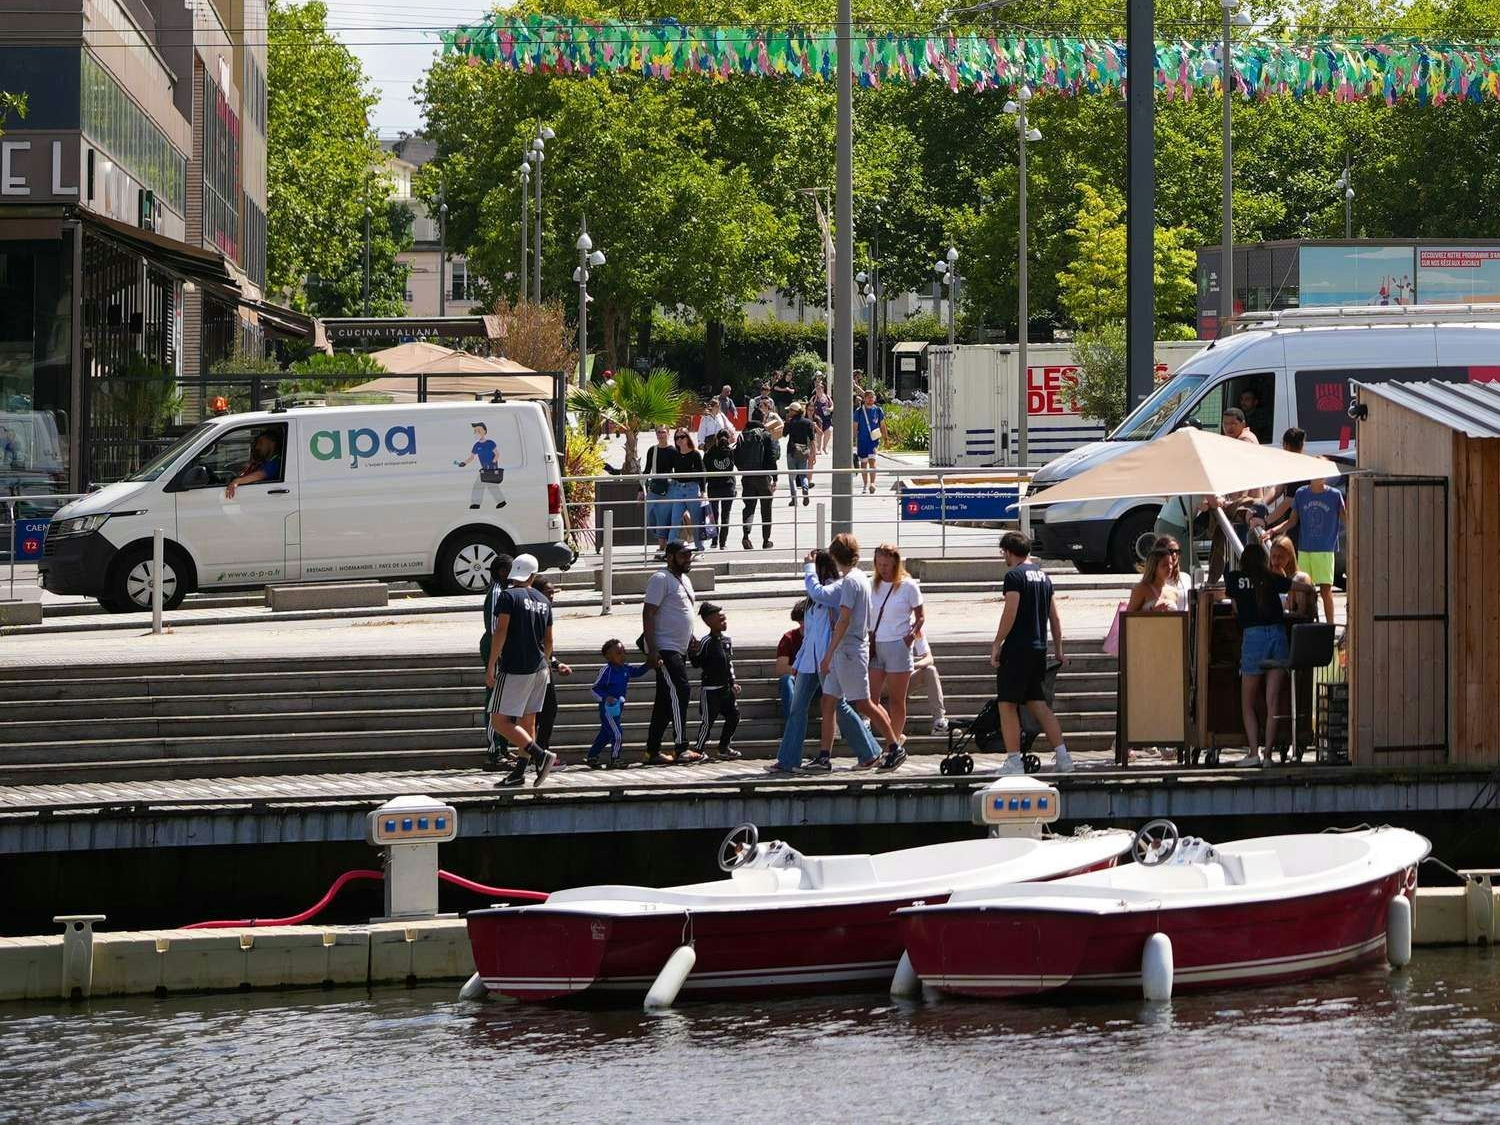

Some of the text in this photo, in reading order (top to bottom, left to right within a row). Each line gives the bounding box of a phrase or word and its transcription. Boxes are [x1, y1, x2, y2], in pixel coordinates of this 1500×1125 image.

[338, 328, 381, 337] CUCINA
[386, 328, 439, 337] ITALIANA
[309, 425, 417, 469] apa
[25, 524, 50, 532] CAEN
